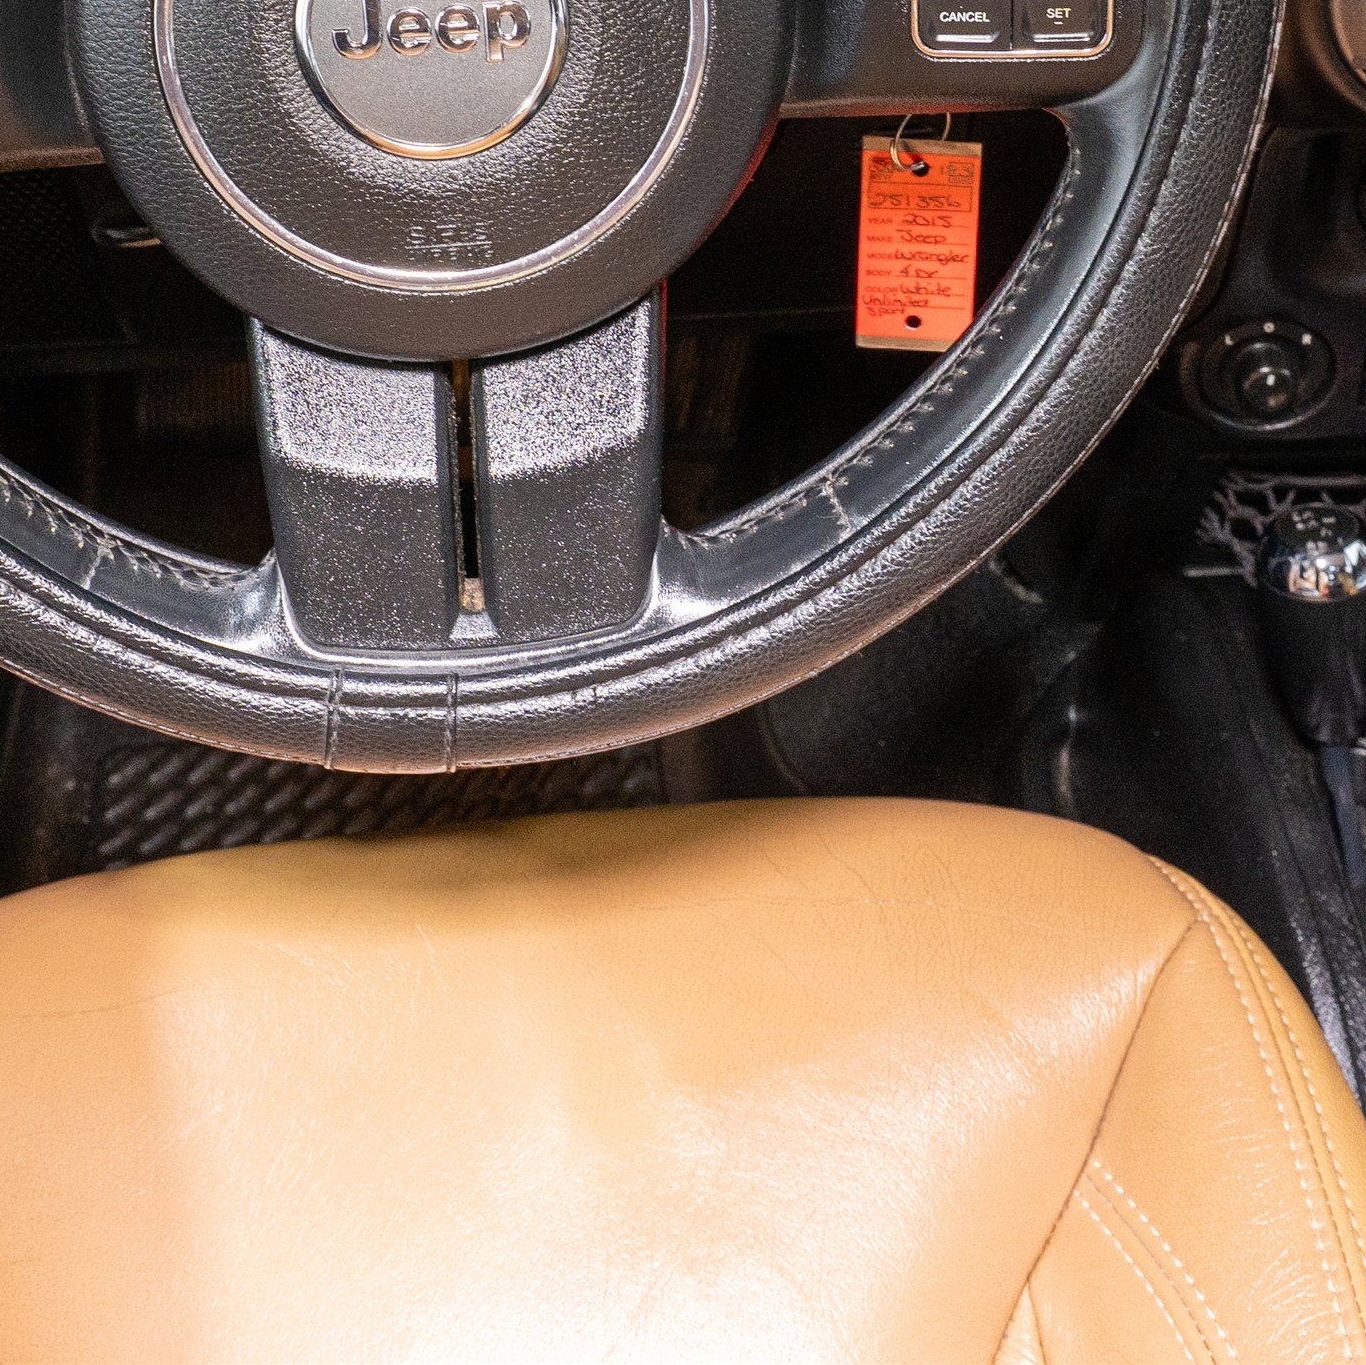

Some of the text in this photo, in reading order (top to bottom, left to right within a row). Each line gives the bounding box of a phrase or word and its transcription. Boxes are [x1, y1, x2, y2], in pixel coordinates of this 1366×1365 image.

[940, 12, 990, 23] CANCEL
[1046, 8, 1071, 19] SET
[902, 212, 953, 228] 2015
[896, 229, 946, 244] Jeep
[894, 250, 970, 265] Wrangler
[900, 282, 951, 296] White
